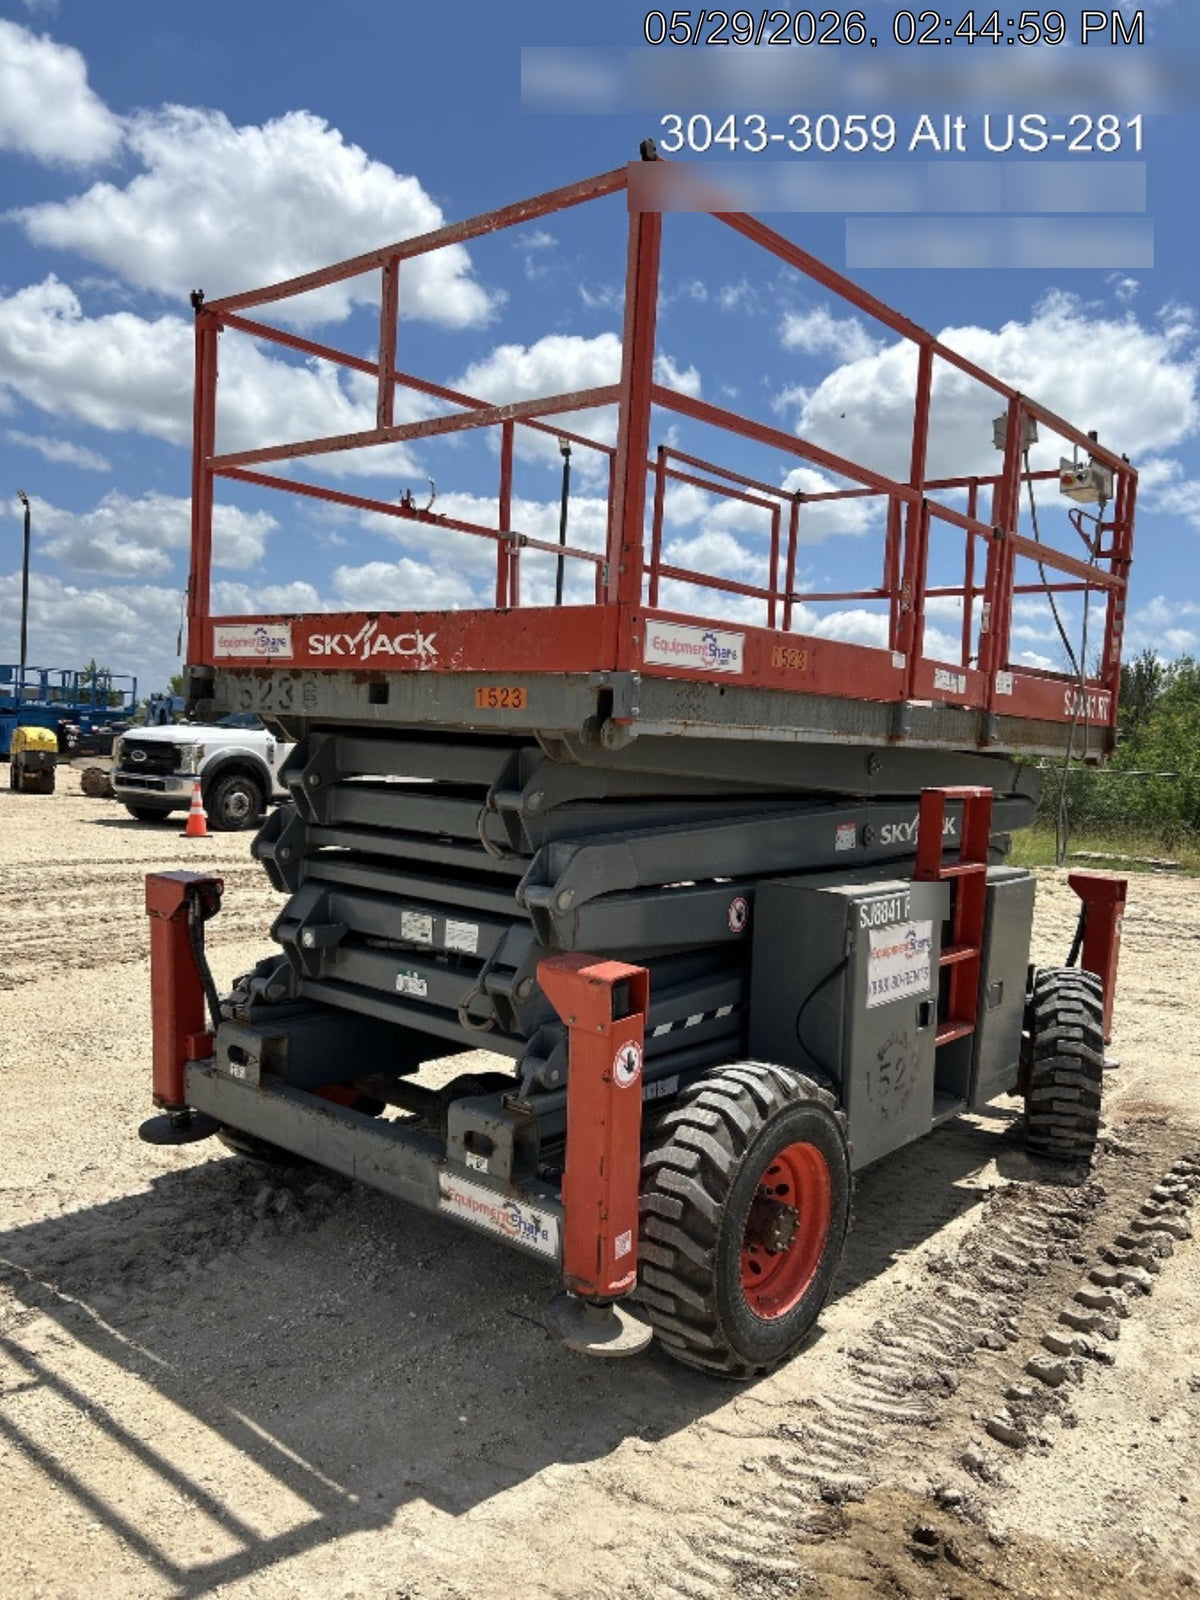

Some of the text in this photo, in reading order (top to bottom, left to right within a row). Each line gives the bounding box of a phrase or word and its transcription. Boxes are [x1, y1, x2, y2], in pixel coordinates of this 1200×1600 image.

[308, 620, 440, 661] SKYJACK
[477, 687, 522, 709] 1523
[860, 898, 901, 929] SJ8841
